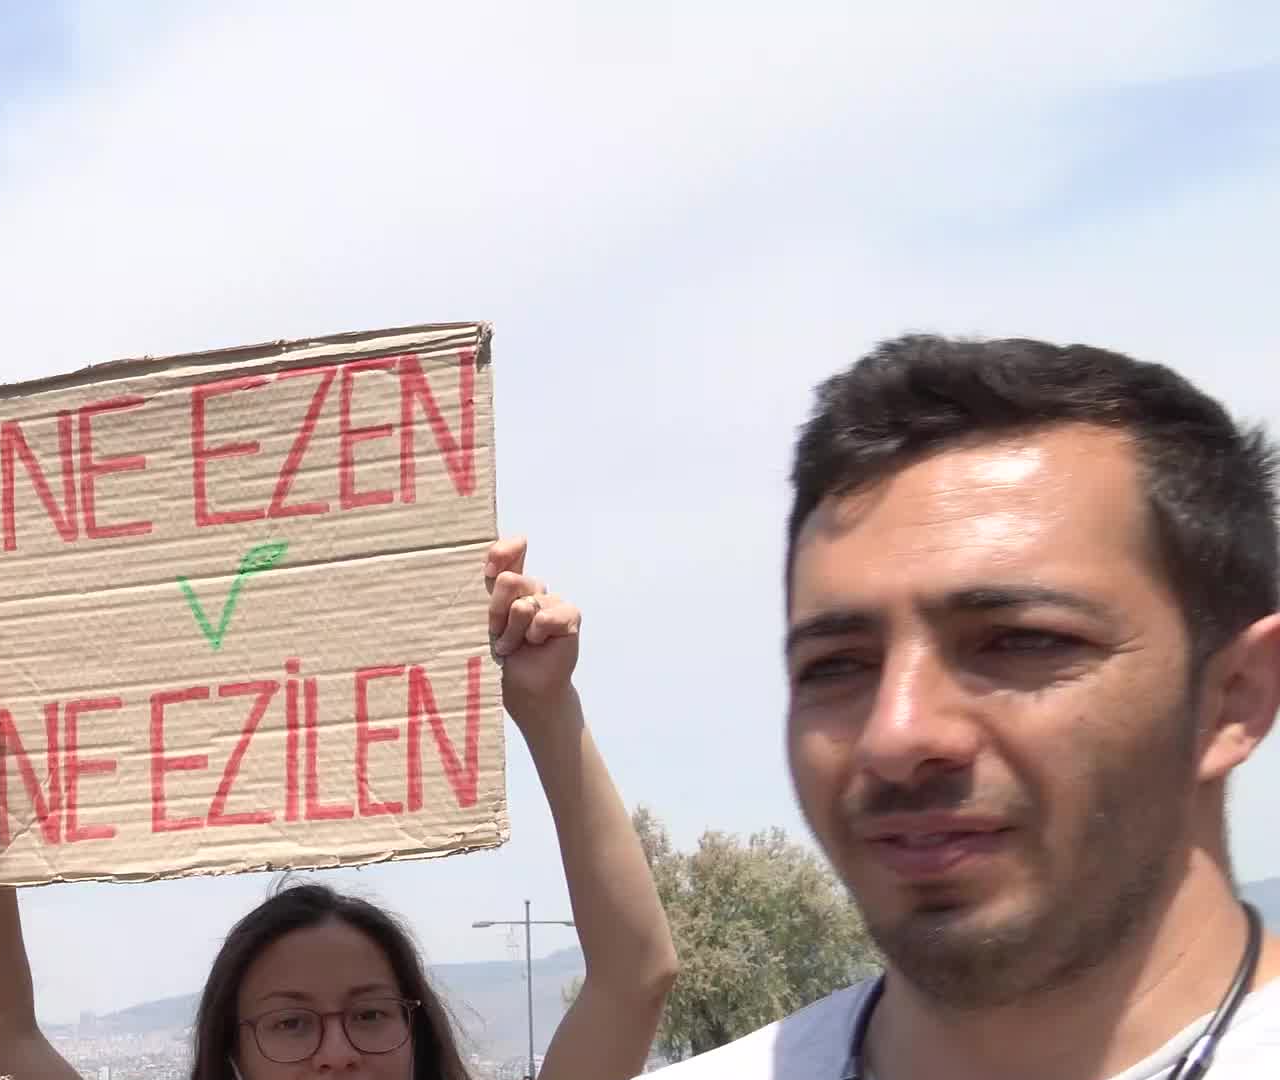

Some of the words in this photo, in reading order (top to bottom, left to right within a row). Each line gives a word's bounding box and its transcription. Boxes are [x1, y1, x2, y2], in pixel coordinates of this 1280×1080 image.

[0, 394, 153, 552] NE
[191, 345, 476, 528] EZEN
[150, 656, 483, 834] EZİLEN
